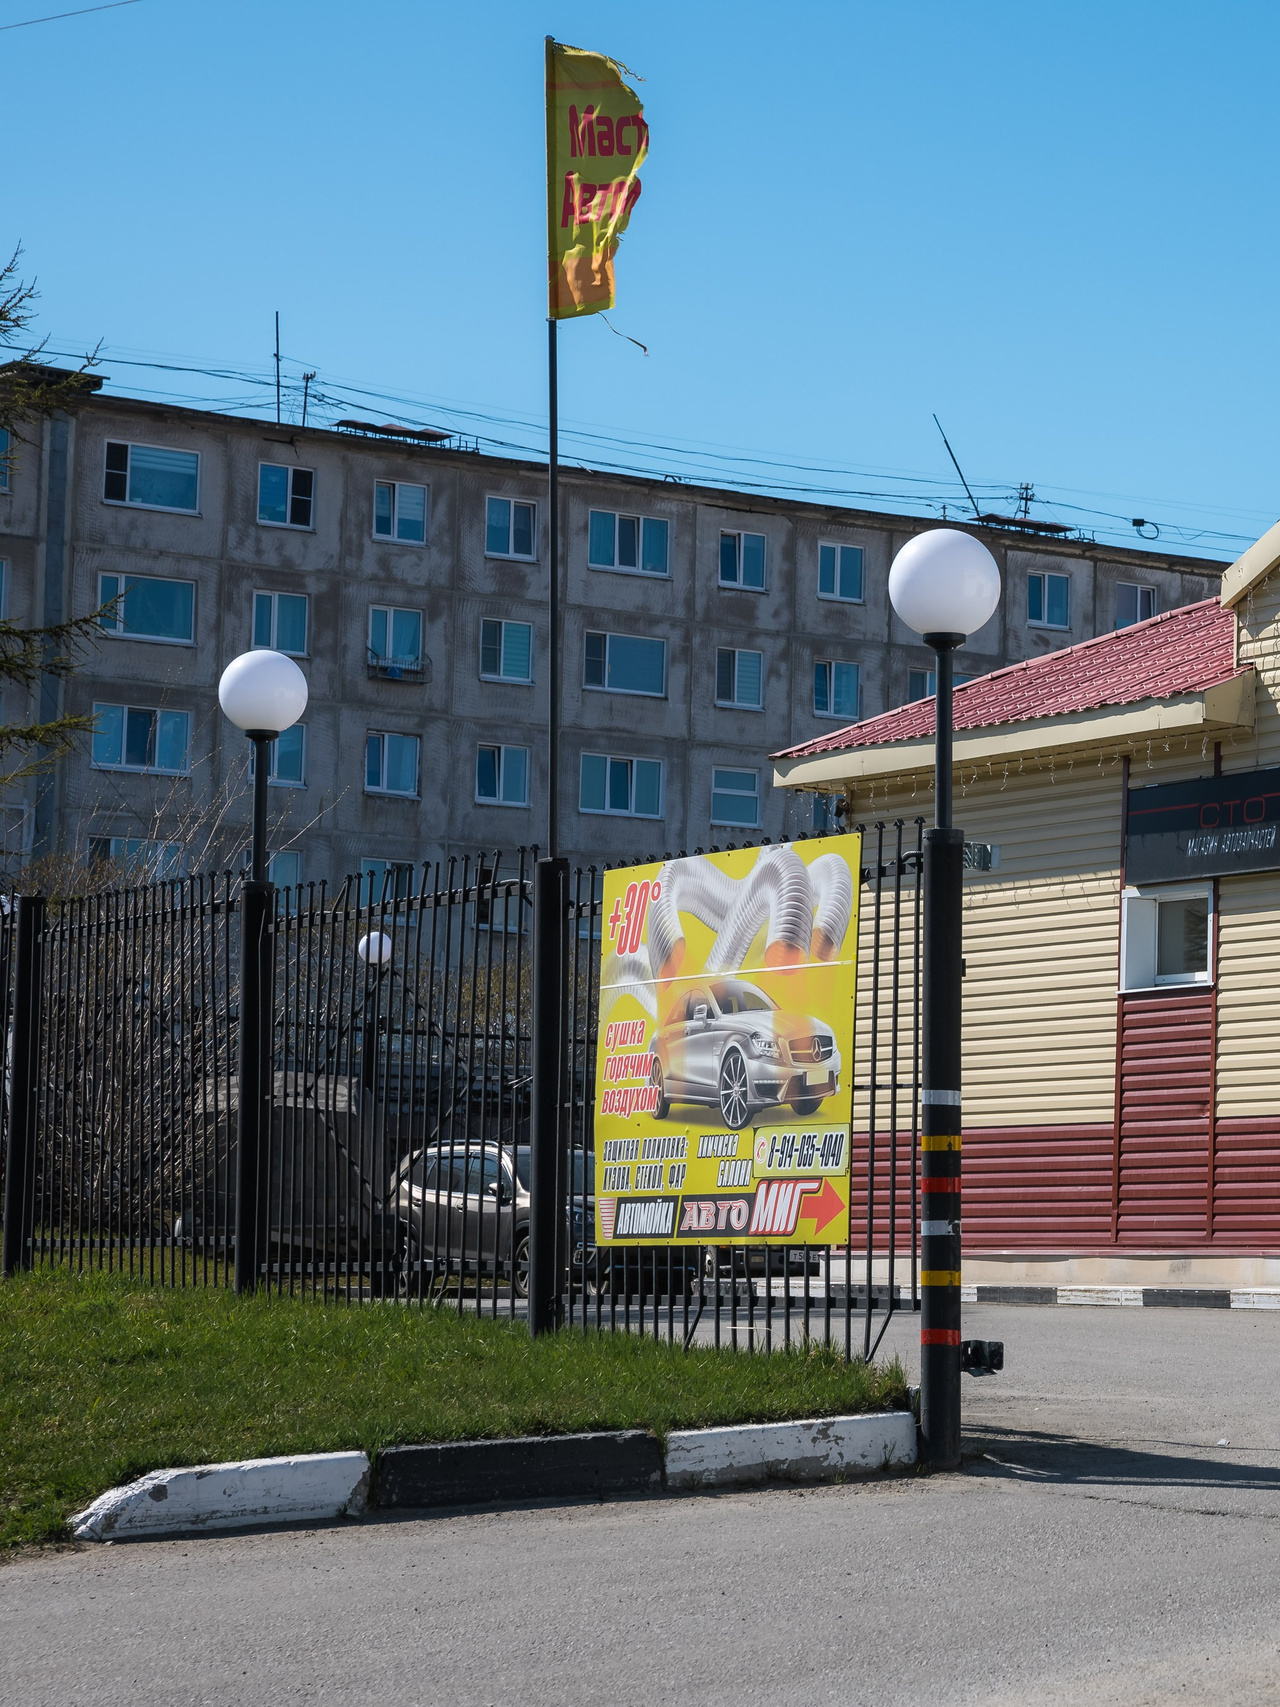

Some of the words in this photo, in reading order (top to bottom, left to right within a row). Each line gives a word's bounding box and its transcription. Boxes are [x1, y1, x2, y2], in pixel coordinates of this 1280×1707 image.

[1200, 797, 1266, 829] СТО
[767, 1133, 844, 1169] 8-914-035-4040
[616, 1199, 675, 1235] АВТОМОЙКА
[680, 1199, 749, 1231] АВТО
[748, 1179, 822, 1236] МИГ
